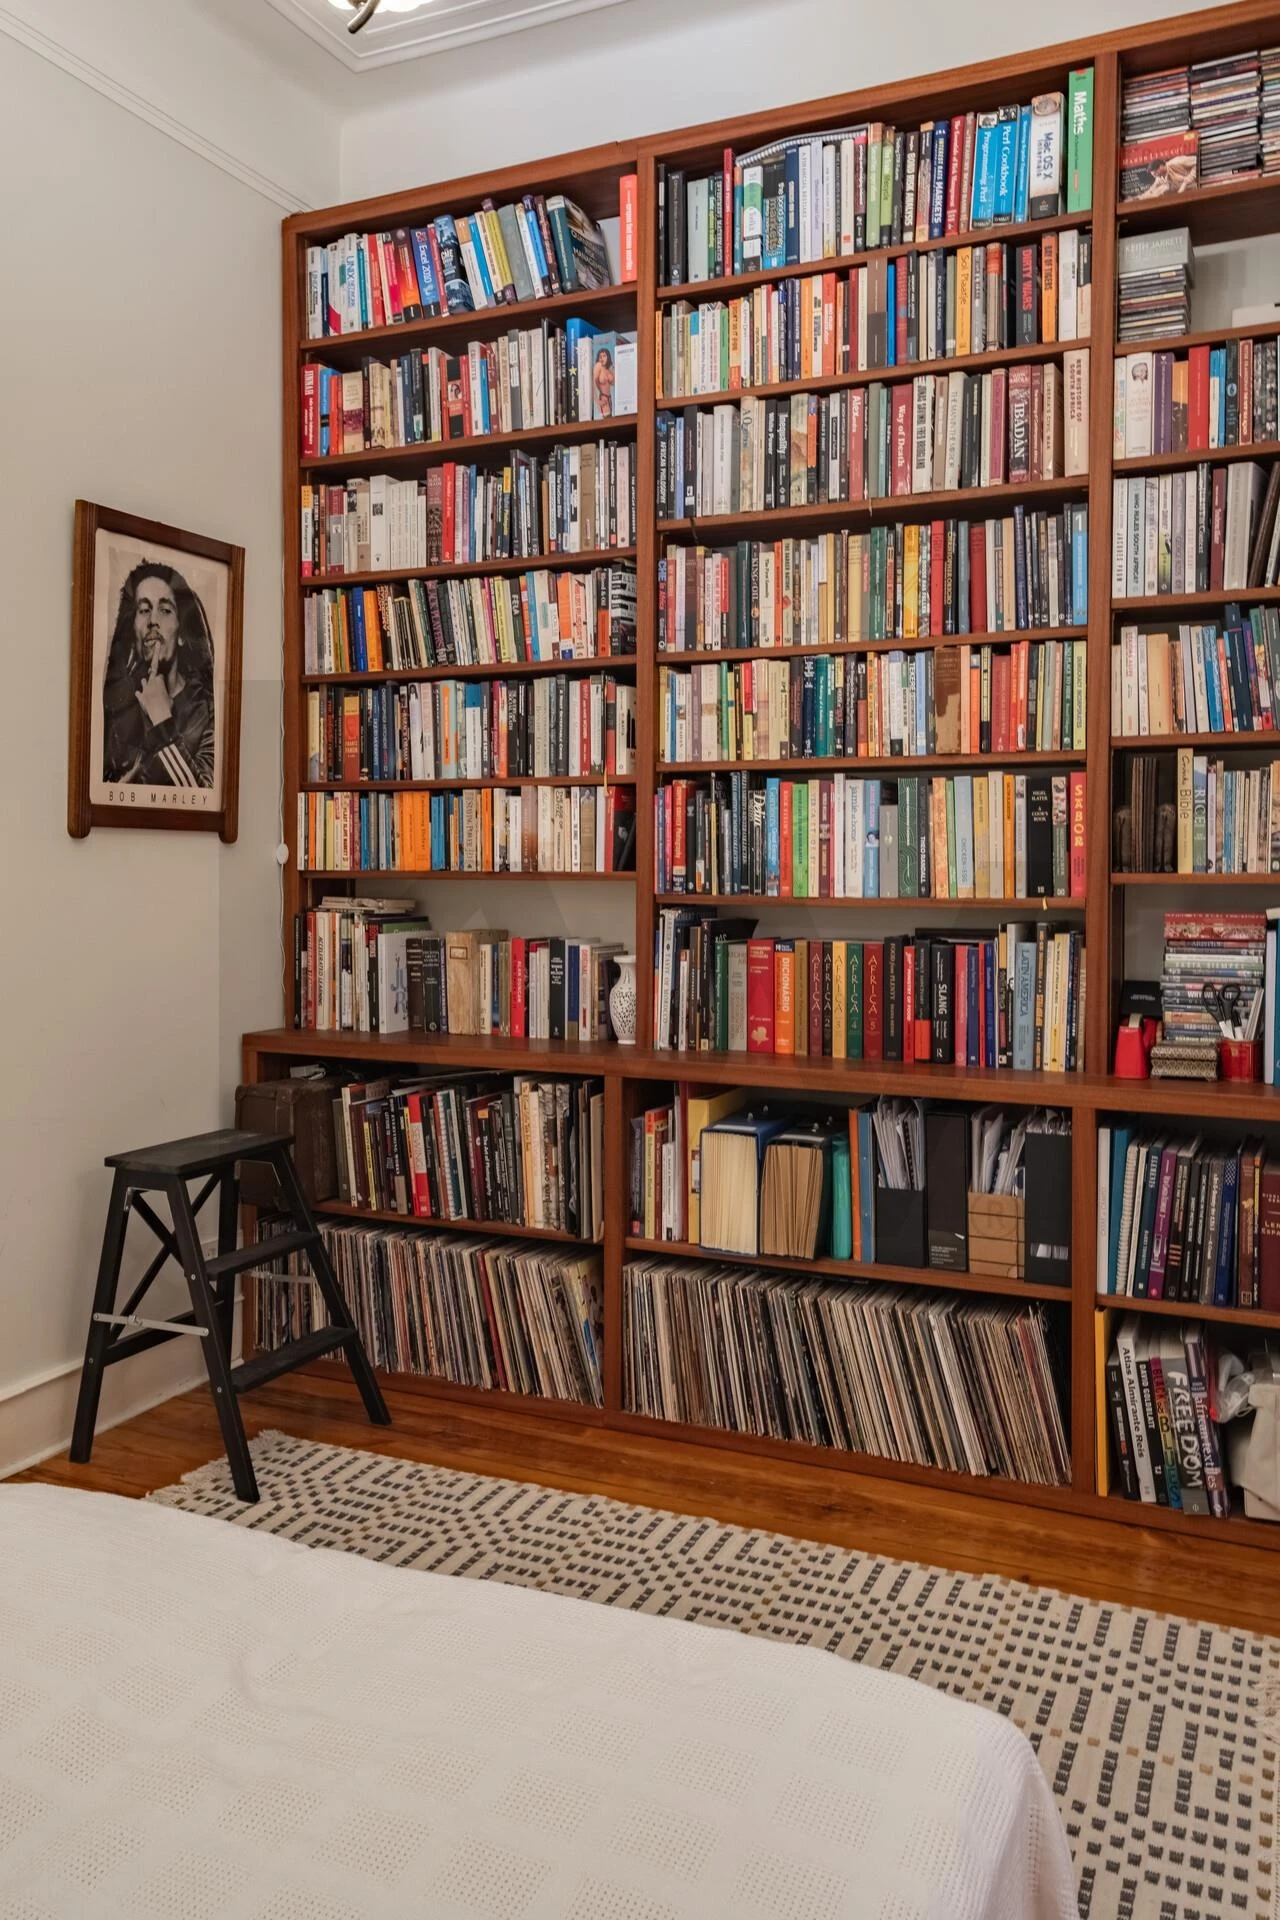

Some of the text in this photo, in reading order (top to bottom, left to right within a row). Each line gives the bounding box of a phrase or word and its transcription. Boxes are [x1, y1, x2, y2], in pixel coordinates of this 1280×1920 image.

[1072, 91, 1087, 136] Maths
[906, 152, 915, 174] BOND
[979, 131, 991, 202] Programming Perl
[999, 125, 1011, 197] Perl Cookbook
[1043, 132, 1053, 180] Mac OS X
[904, 192, 914, 226] ANALYSIS
[934, 181, 944, 224] MARKETS
[420, 244, 432, 282] Excel 2010
[960, 254, 969, 272] Sol
[1021, 248, 1032, 311] DIRTY WARS
[304, 370, 314, 395] JINNAH
[776, 413, 788, 454] Inequality
[896, 404, 906, 468] Way of Death
[1076, 411, 1082, 423] OF
[766, 433, 774, 455] Power
[658, 559, 666, 581] CHE
[109, 791, 208, 805] BOB MARLEY
[848, 784, 859, 813] jamie
[1074, 784, 1084, 847] SABOR
[1178, 789, 1191, 819] Bible
[1193, 788, 1206, 824] RICE
[811, 953, 820, 1011] AFRICA
[824, 953, 832, 1011] AFRICA
[850, 954, 859, 1014] AFRICA
[867, 954, 878, 1014] AFRICA
[937, 983, 948, 1015] SLANG
[1019, 949, 1029, 1017] LATIN AMERICA
[484, 1162, 492, 1196] Photography
[1122, 1347, 1146, 1458] Atlas Almirante Reis
[1139, 1364, 1155, 1429] DAVID GOLDBLATT
[1152, 1368, 1166, 1400] BLACK
[1159, 1416, 1180, 1502] BLUES
[1167, 1371, 1203, 1488] FREEDOM
